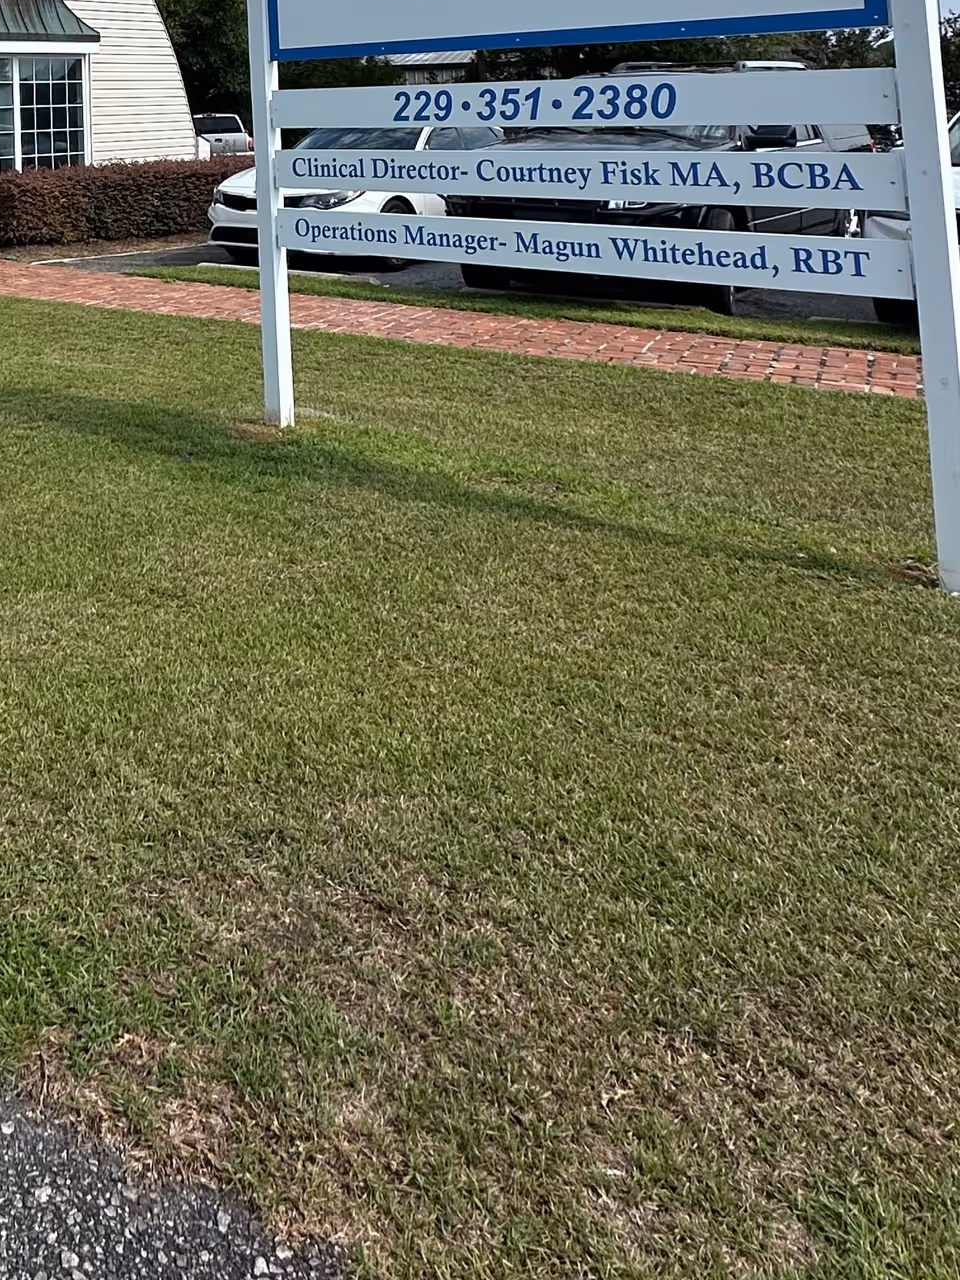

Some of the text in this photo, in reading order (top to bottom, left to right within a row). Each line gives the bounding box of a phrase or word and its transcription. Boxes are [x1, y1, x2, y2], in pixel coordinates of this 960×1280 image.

[292, 157, 864, 194] Clinical Director- Courtney Fisk MA, BCBA
[295, 218, 871, 278] Operations Manager- Magun Whitehead, RBT
